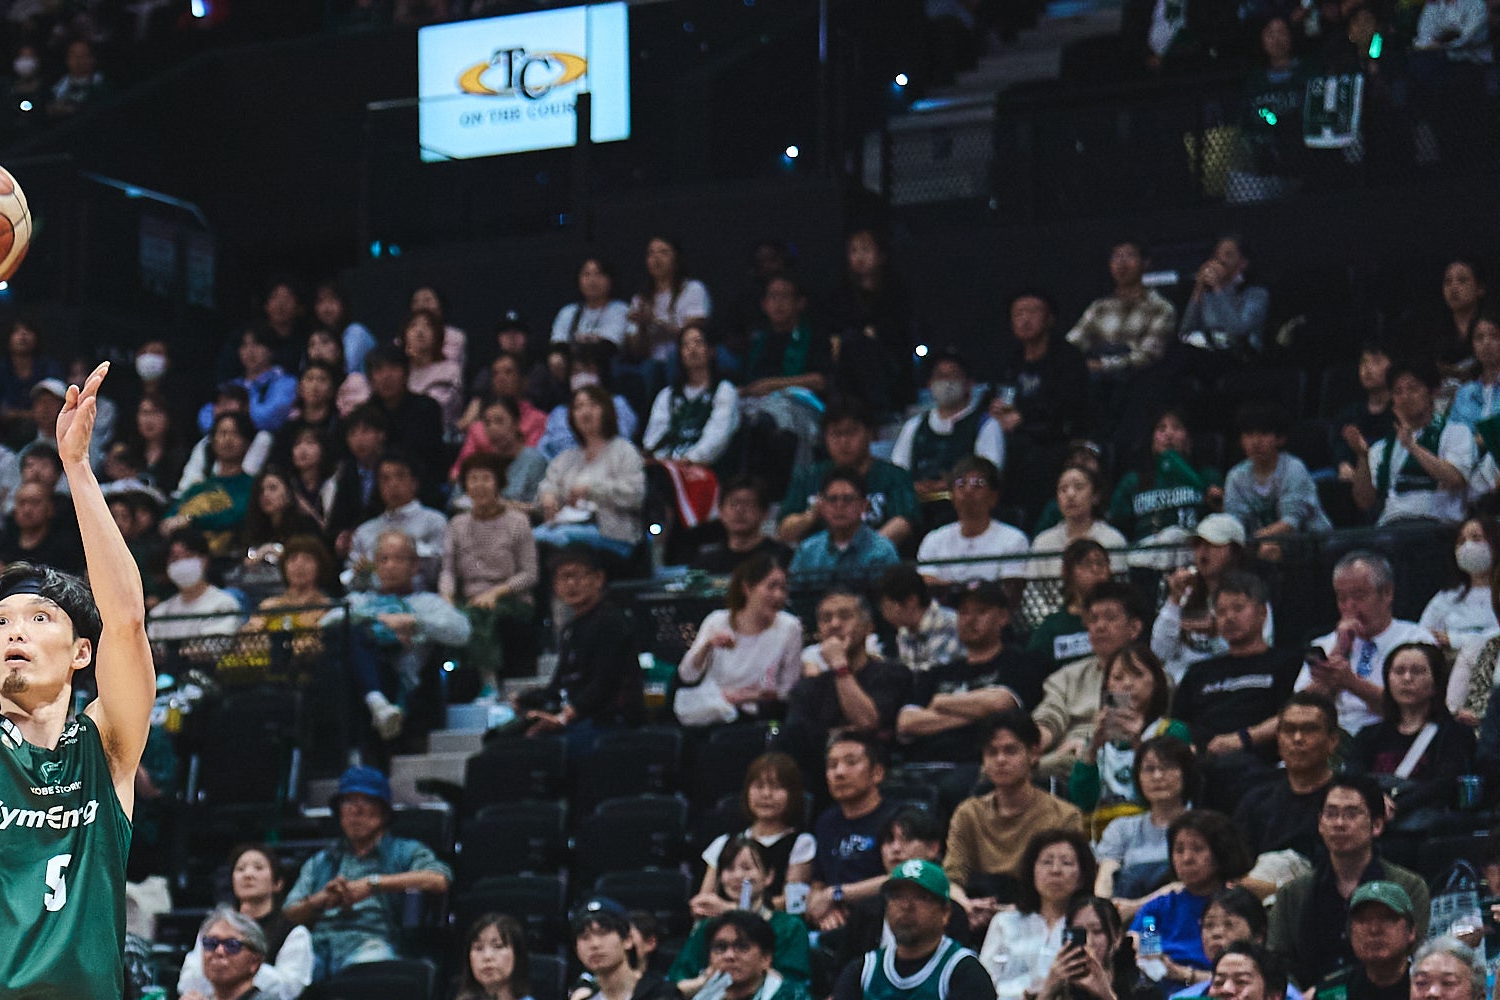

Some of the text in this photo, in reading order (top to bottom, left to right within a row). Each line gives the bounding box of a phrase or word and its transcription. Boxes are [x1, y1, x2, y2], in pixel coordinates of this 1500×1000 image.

[527, 103, 577, 119] COUR
[55, 781, 82, 794] STORK
[44, 854, 72, 911] 5
